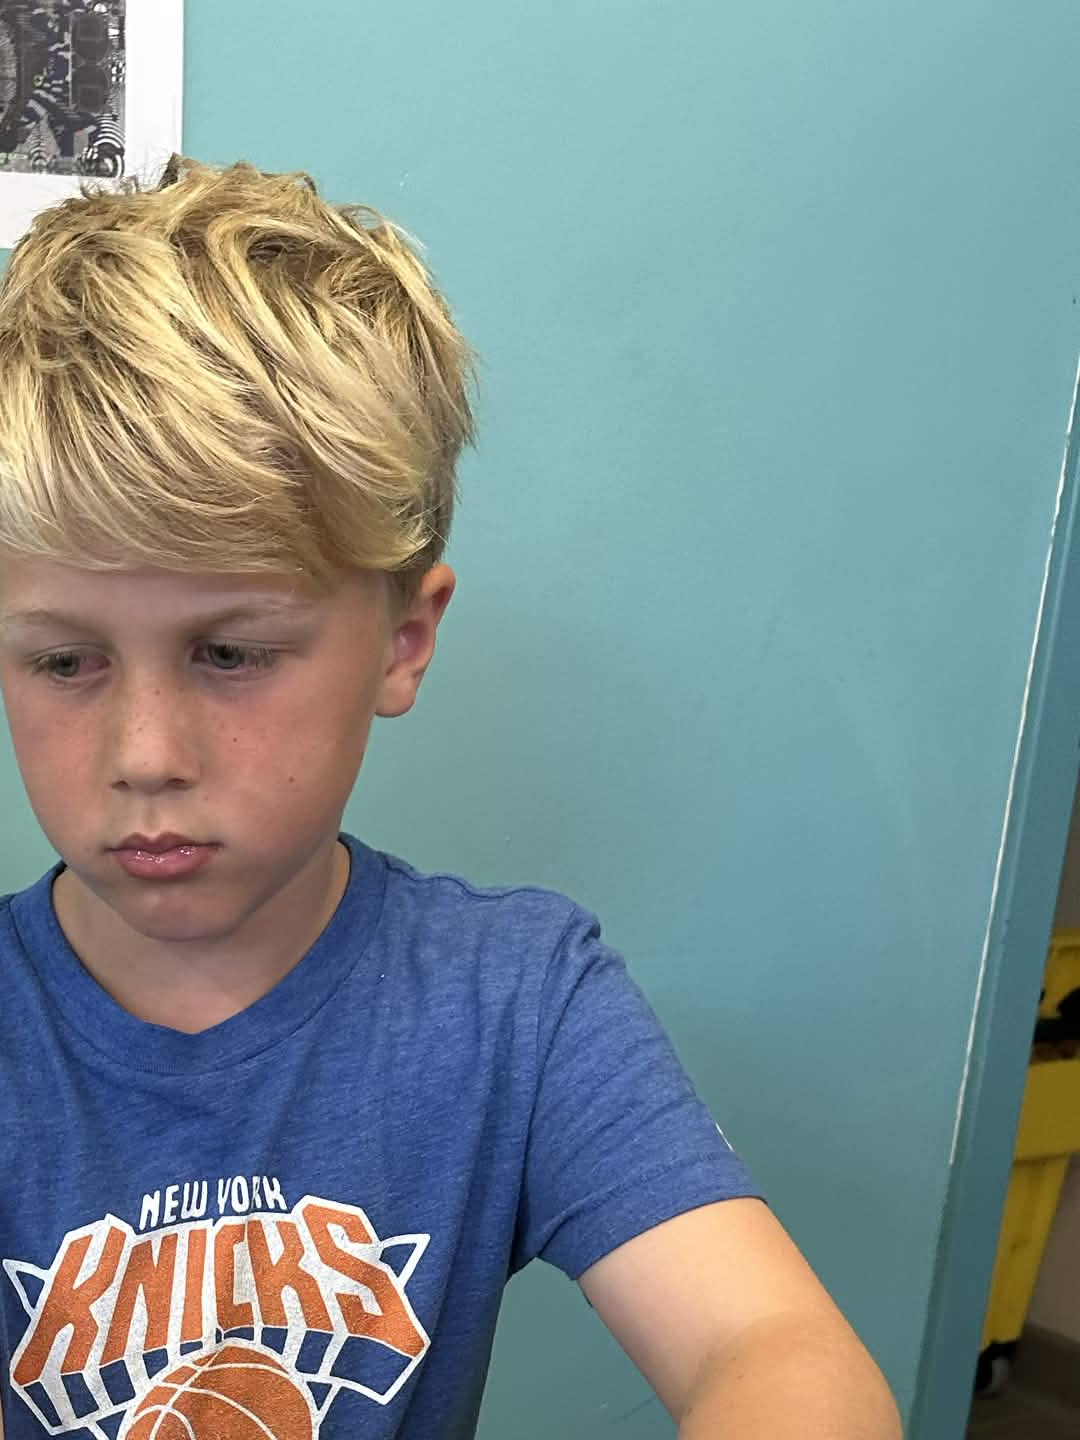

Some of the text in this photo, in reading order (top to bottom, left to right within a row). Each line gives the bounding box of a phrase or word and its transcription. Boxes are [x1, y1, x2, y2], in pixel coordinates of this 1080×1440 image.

[138, 1175, 288, 1231] NEW YORK
[10, 1199, 430, 1391] KNICKS
